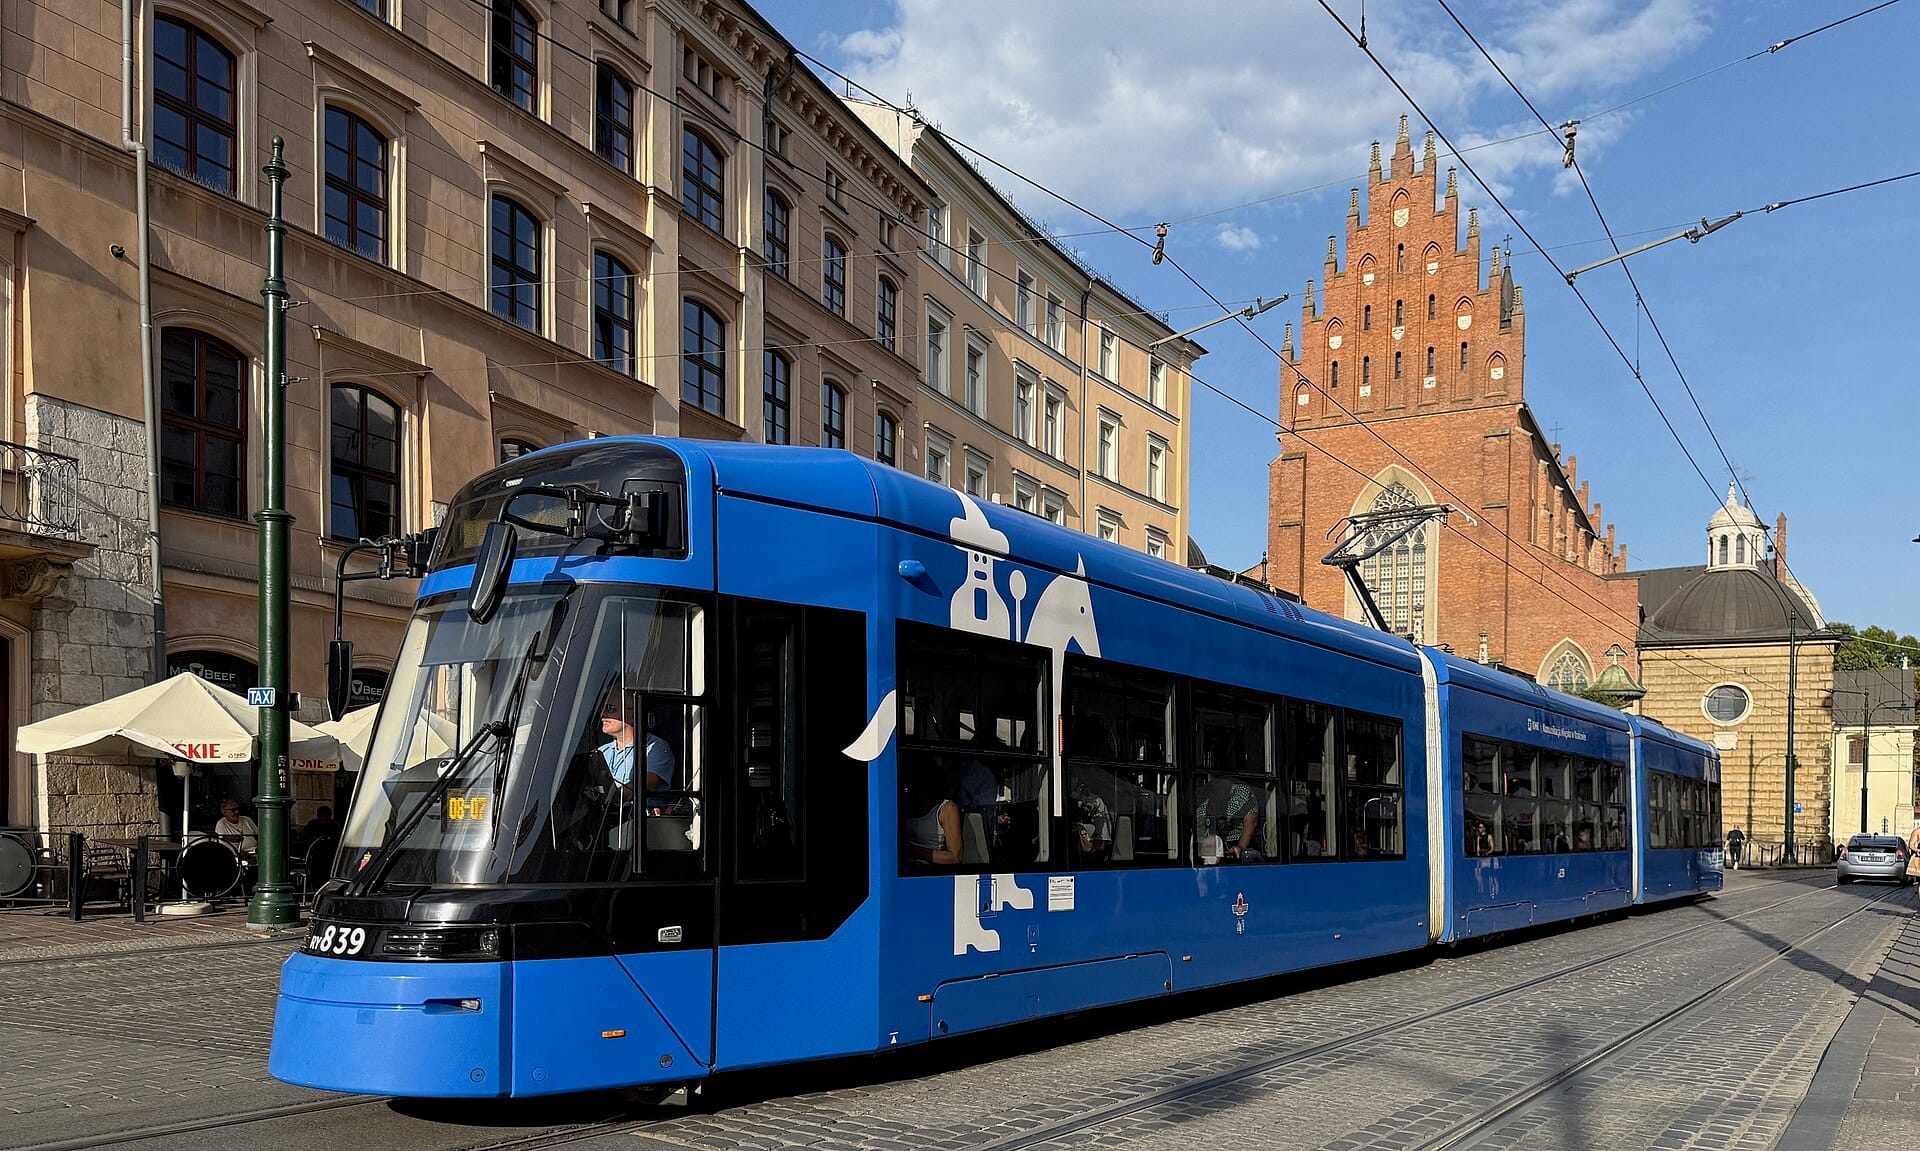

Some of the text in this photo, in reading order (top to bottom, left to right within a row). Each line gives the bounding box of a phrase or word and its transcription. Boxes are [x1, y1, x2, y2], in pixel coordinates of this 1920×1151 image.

[204, 669, 236, 681] BEEF
[250, 690, 273, 705] TAXI
[172, 743, 221, 759] SKIE
